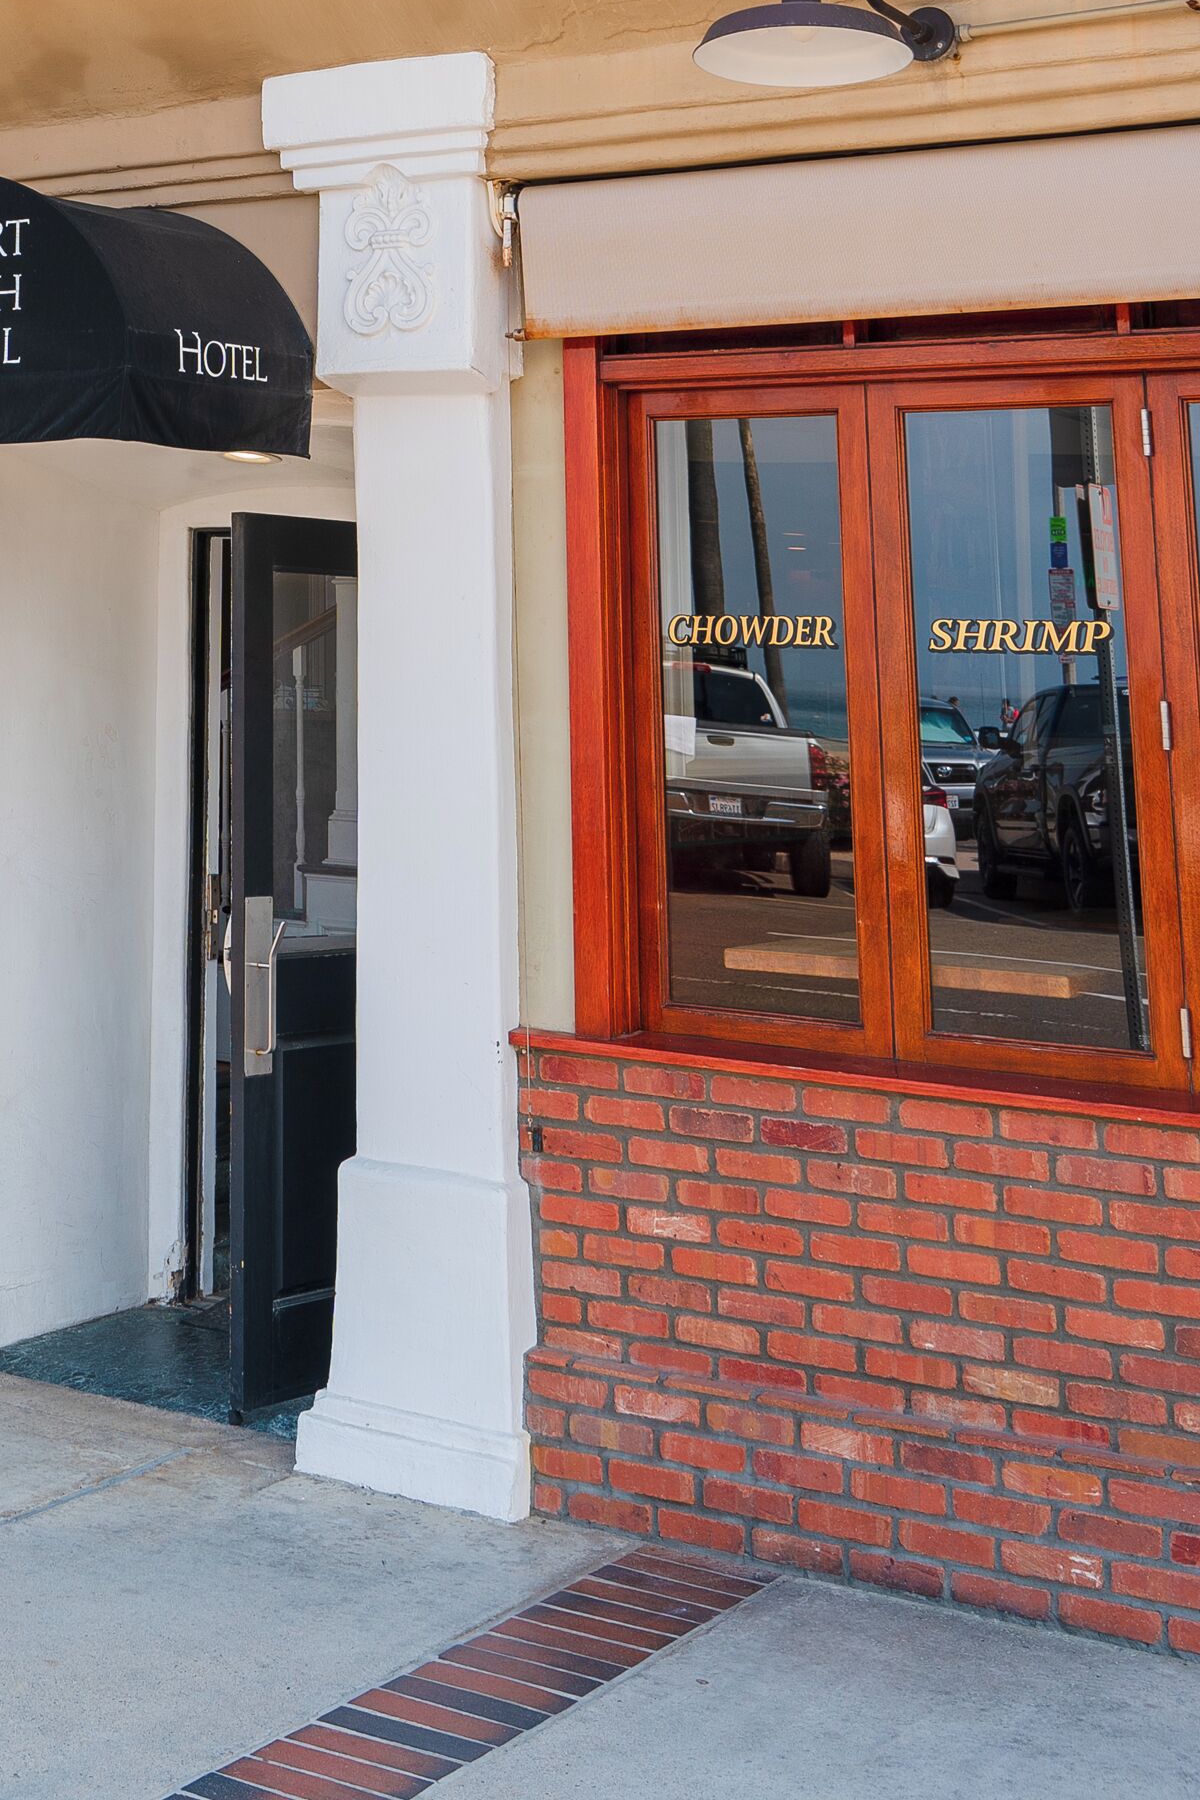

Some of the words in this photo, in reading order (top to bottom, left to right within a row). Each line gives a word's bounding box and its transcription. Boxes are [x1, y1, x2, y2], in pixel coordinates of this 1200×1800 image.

[174, 328, 269, 383] HOTEL
[668, 614, 838, 649] CHOWDER
[929, 618, 1114, 654] SHRIMP
